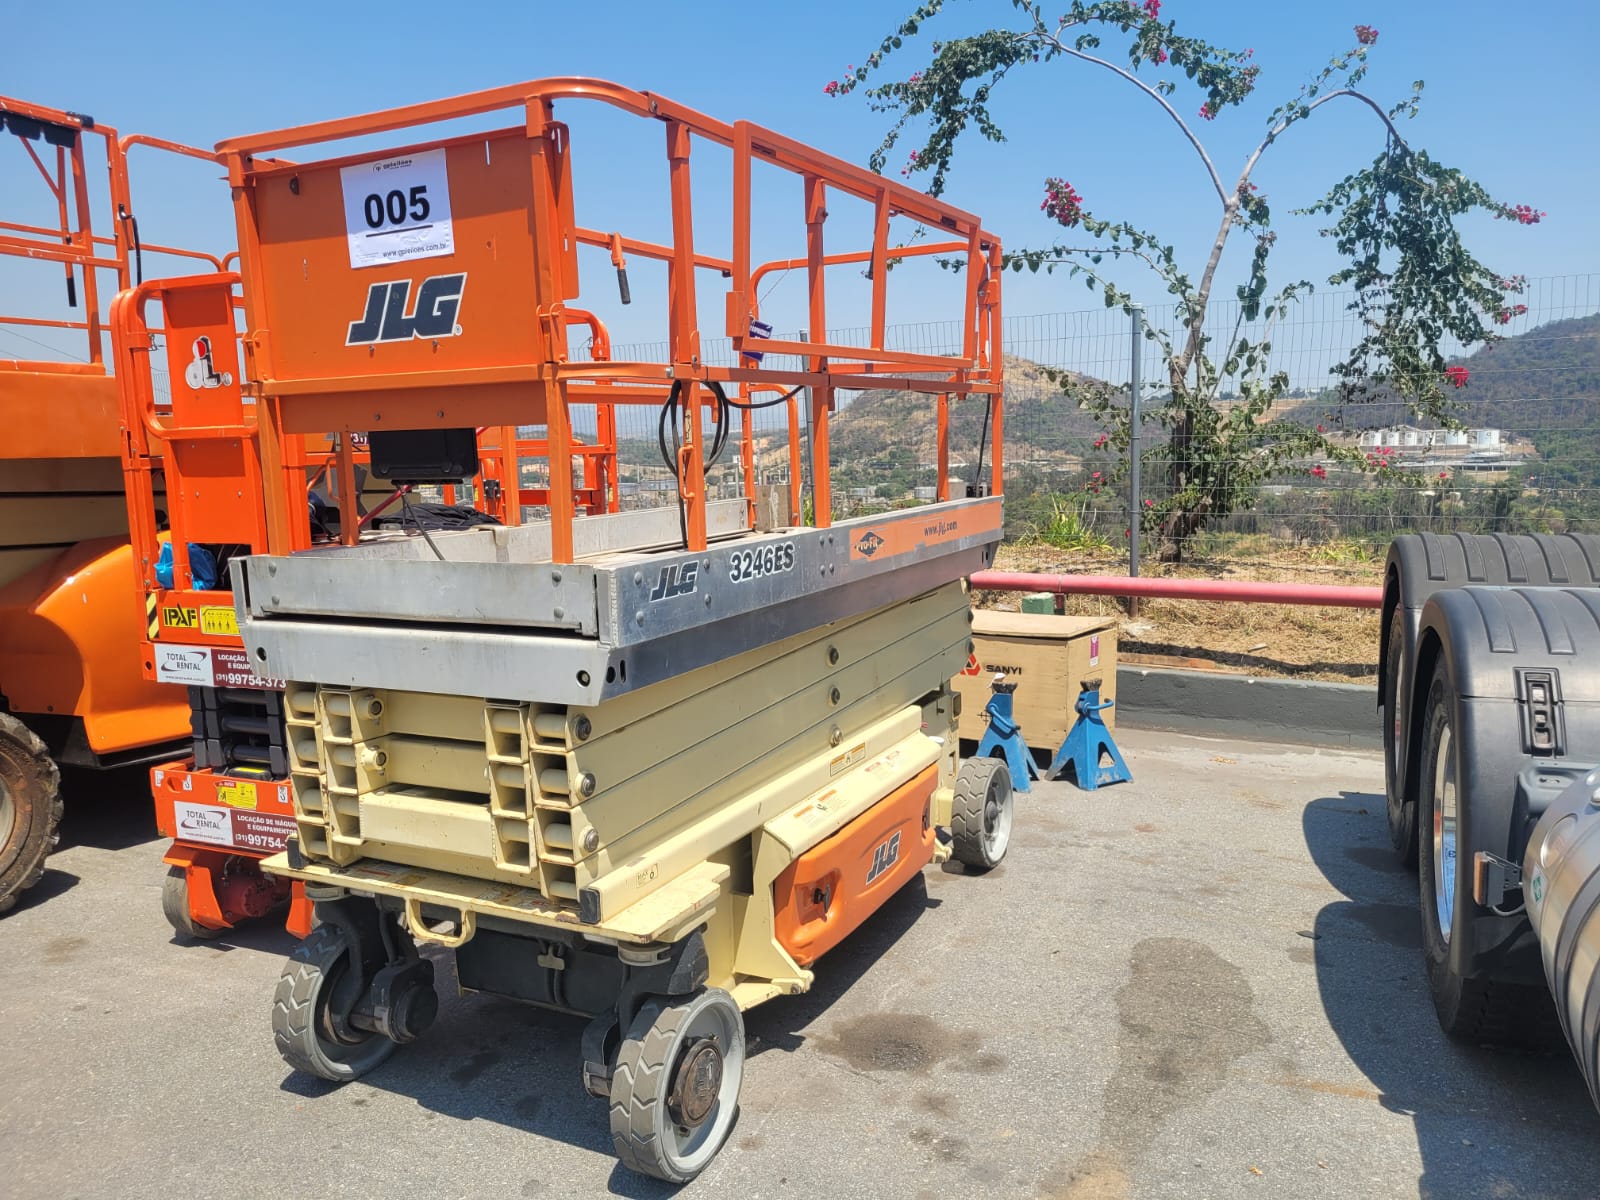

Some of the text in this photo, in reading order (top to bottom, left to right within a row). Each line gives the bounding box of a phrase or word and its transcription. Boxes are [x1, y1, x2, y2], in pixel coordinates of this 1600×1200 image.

[364, 185, 430, 228] 005
[345, 272, 467, 346] JLG
[923, 521, 958, 537] www.jlg.com
[650, 541, 795, 602] JLG 3246ES
[164, 603, 197, 627] IPAF
[166, 652, 187, 662] TOTAL
[217, 653, 246, 662] LOCAÇÃO
[176, 661, 202, 671] RENTAL
[986, 664, 1022, 675] SANYI
[186, 810, 207, 820] TOTAL
[237, 814, 265, 824] LOCAÇÃO
[196, 819, 221, 830] RENTAL
[247, 833, 288, 848] 99754-
[865, 830, 902, 886] JLG
